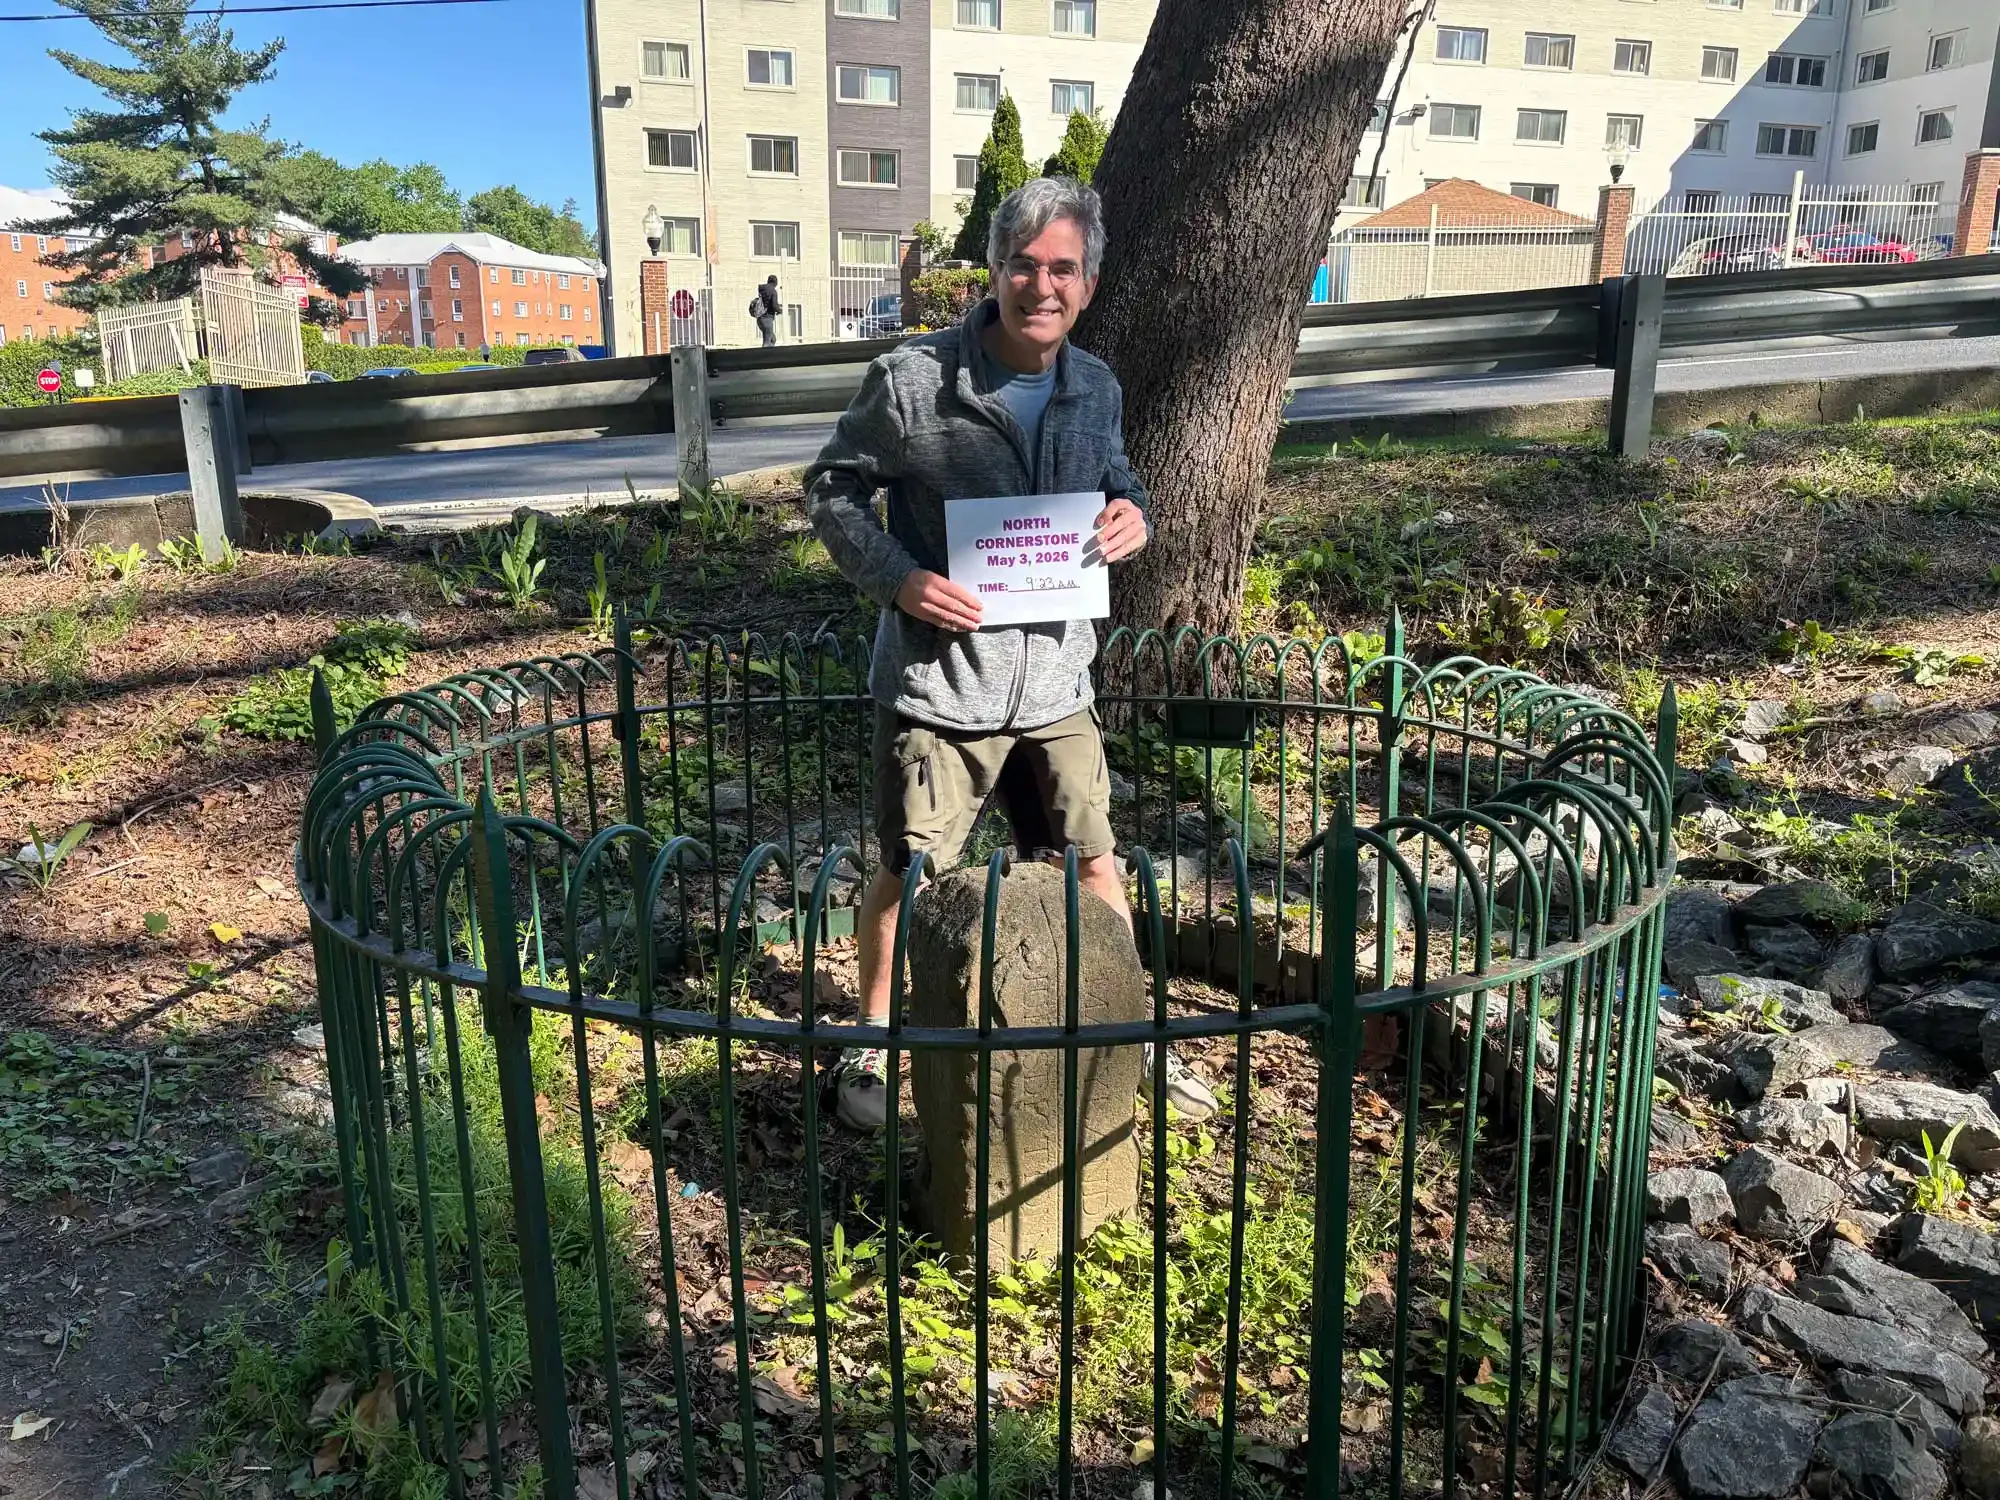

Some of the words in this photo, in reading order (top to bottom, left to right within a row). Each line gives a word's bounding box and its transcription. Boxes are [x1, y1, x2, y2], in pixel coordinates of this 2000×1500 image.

[40, 377, 58, 385] STOP
[1003, 517, 1051, 531] NORTH
[975, 533, 1080, 550] CORNERSTONE
[987, 555, 1016, 568] May
[1019, 553, 1032, 566] 3,
[1035, 551, 1069, 564] 2026
[977, 582, 1009, 593] TIME:
